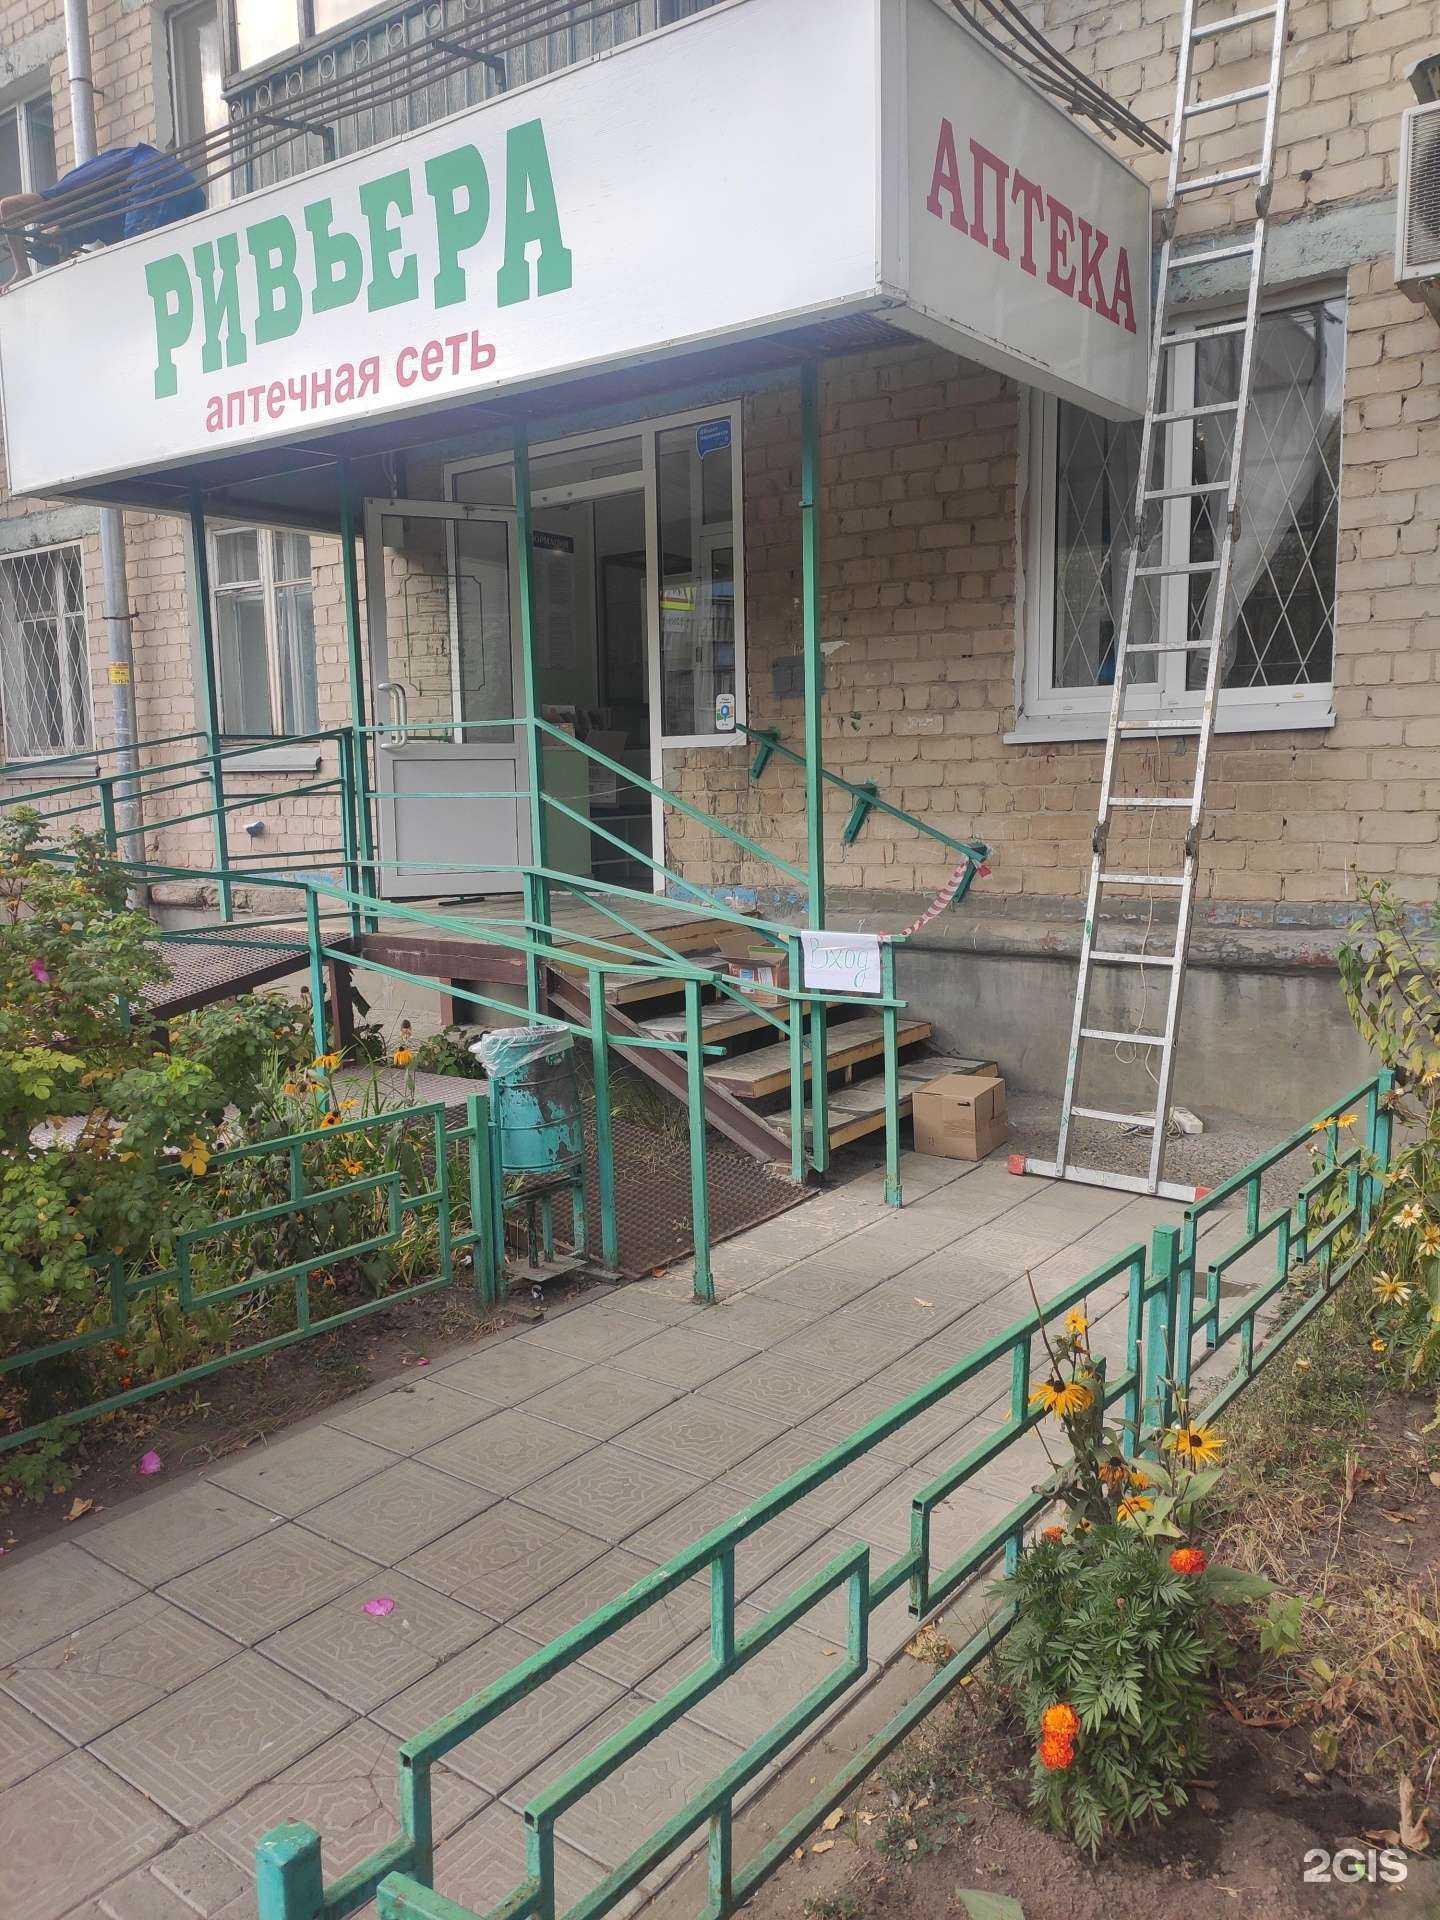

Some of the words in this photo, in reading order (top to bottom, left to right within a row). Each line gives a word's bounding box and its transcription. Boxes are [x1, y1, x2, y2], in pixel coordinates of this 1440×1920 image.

[144, 118, 572, 399] РИВЬЕРА
[926, 117, 1137, 334] АПТЕКА
[206, 355, 380, 433] аптечная
[397, 329, 496, 388] сеть
[809, 937, 870, 988] Вход
